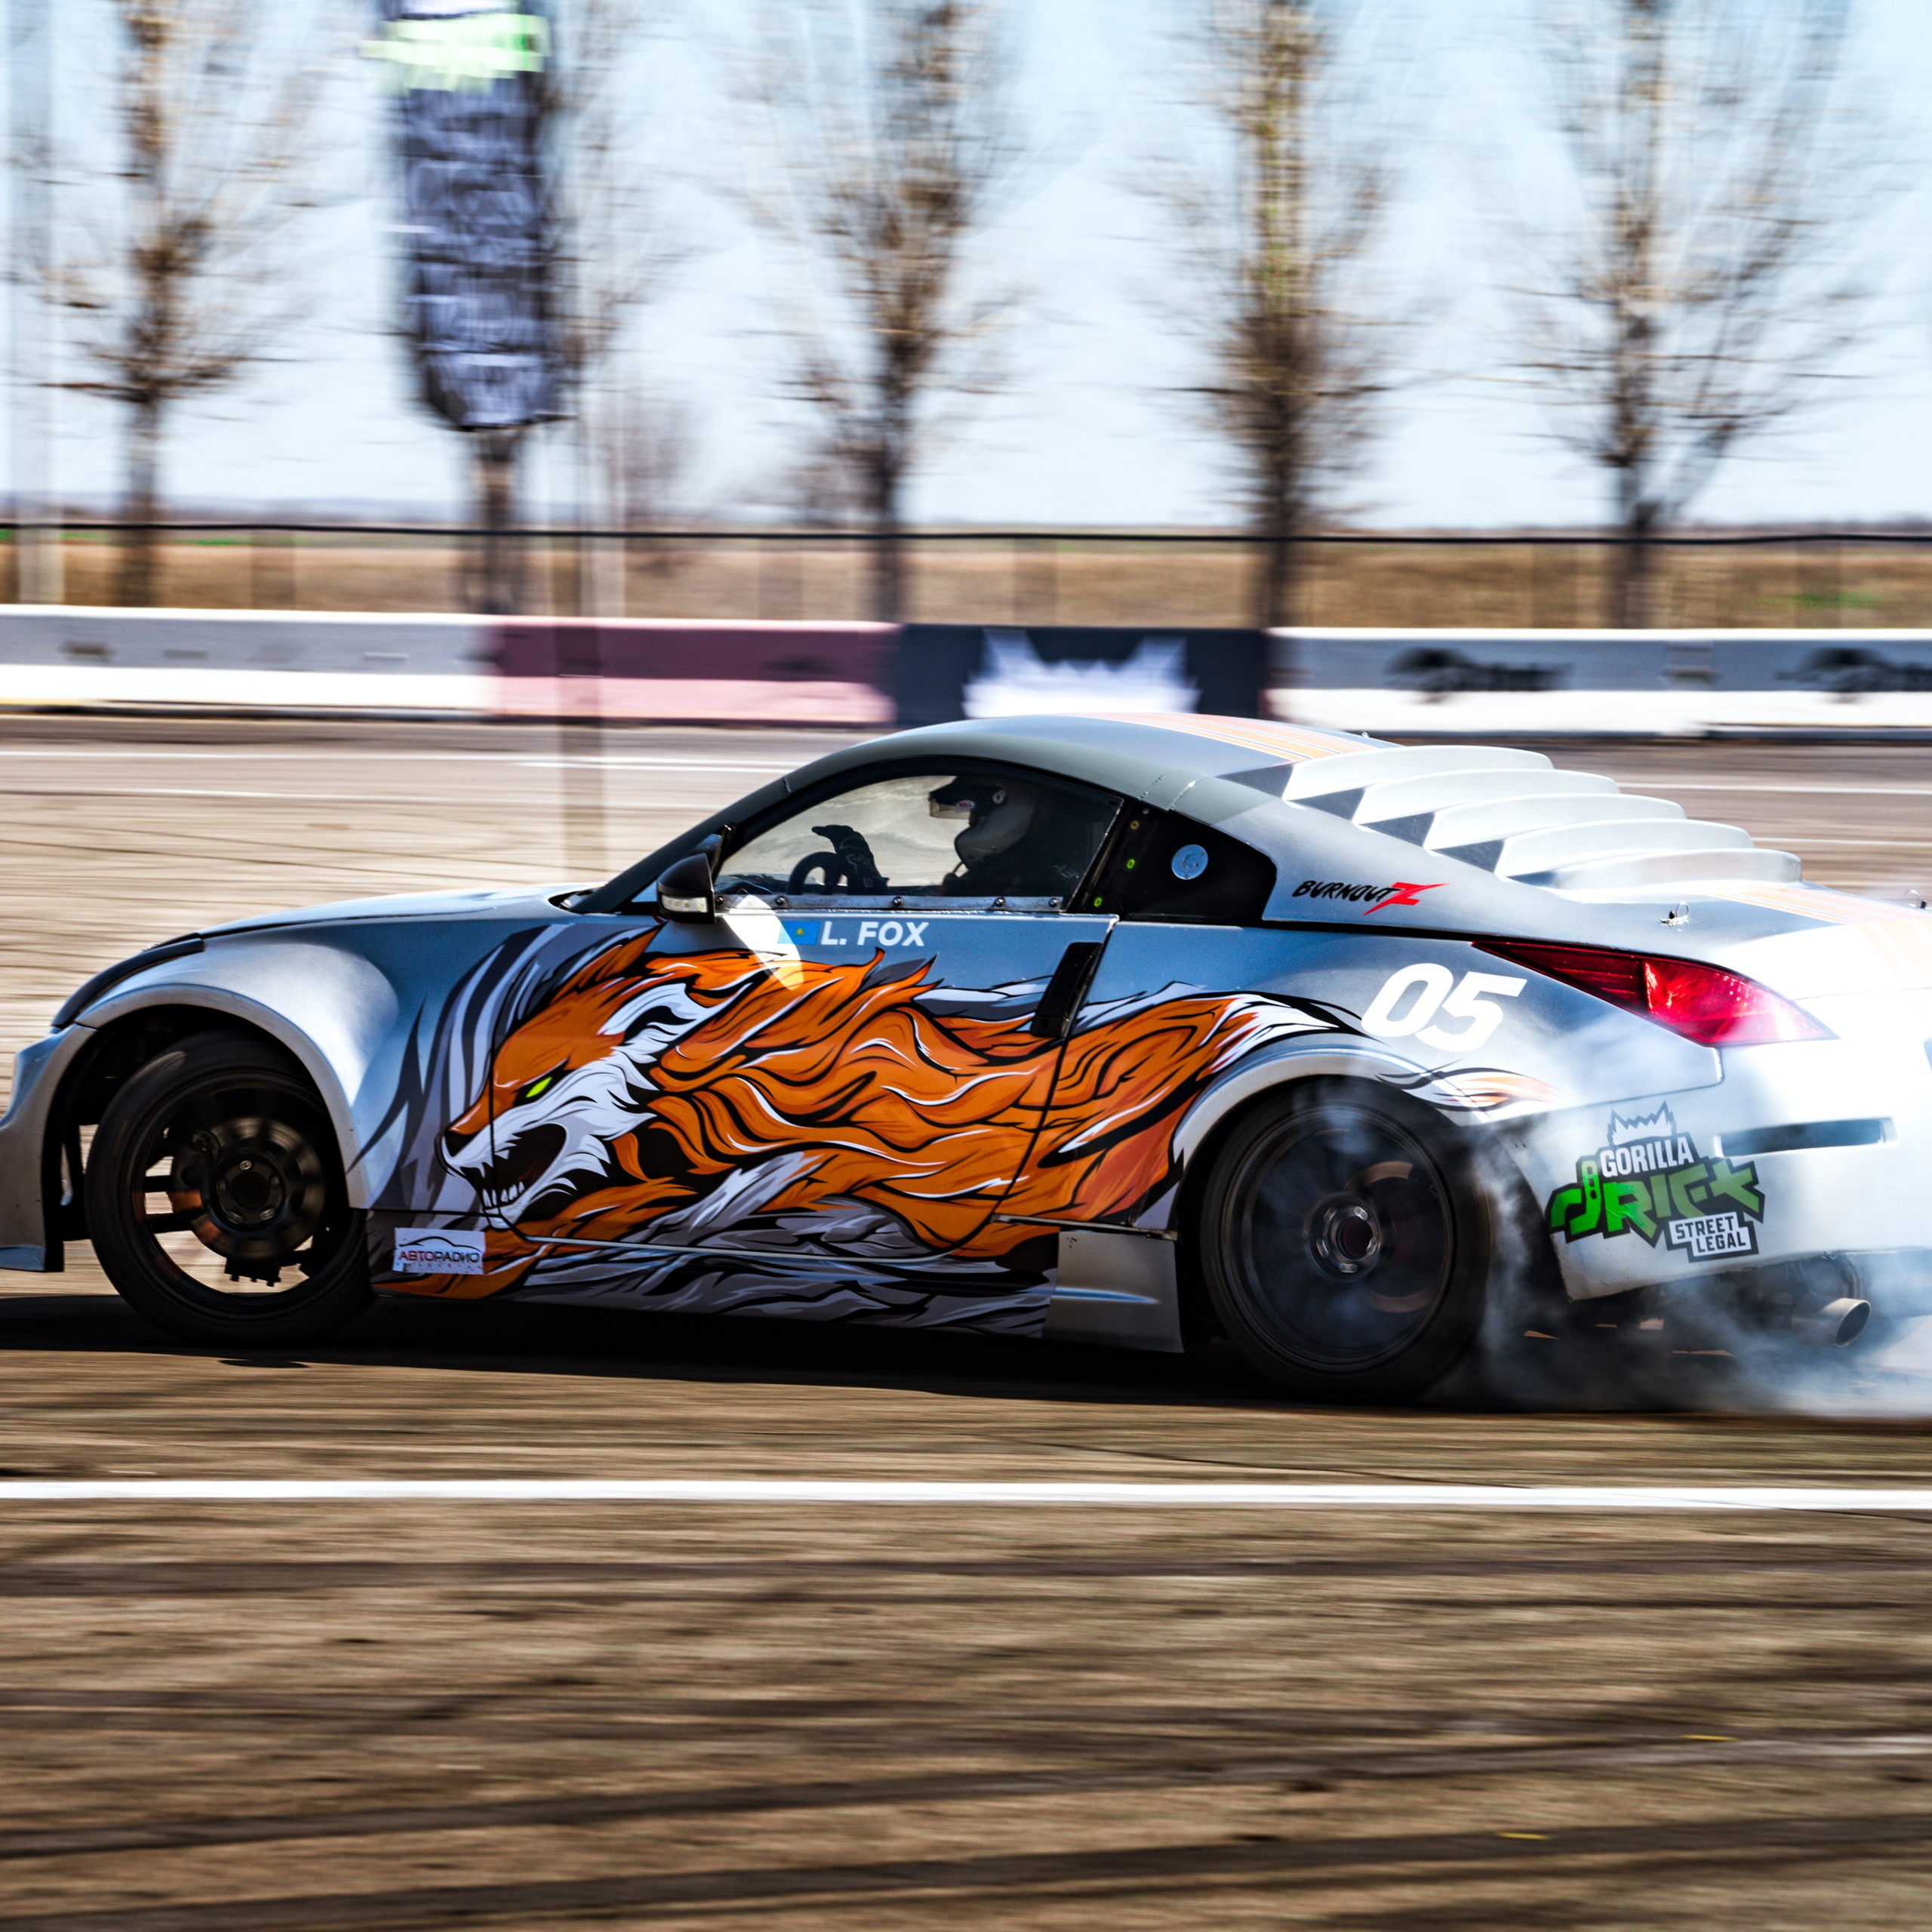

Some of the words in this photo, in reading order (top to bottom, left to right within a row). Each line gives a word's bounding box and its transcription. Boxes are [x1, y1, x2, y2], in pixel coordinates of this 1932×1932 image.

[820, 921, 847, 946] L.
[857, 921, 929, 946] FOX
[1361, 962, 1527, 1052] 05
[1599, 1136, 1694, 1178] GORILLA
[1675, 1216, 1735, 1239] STREET
[1697, 1231, 1746, 1253] LEGAL
